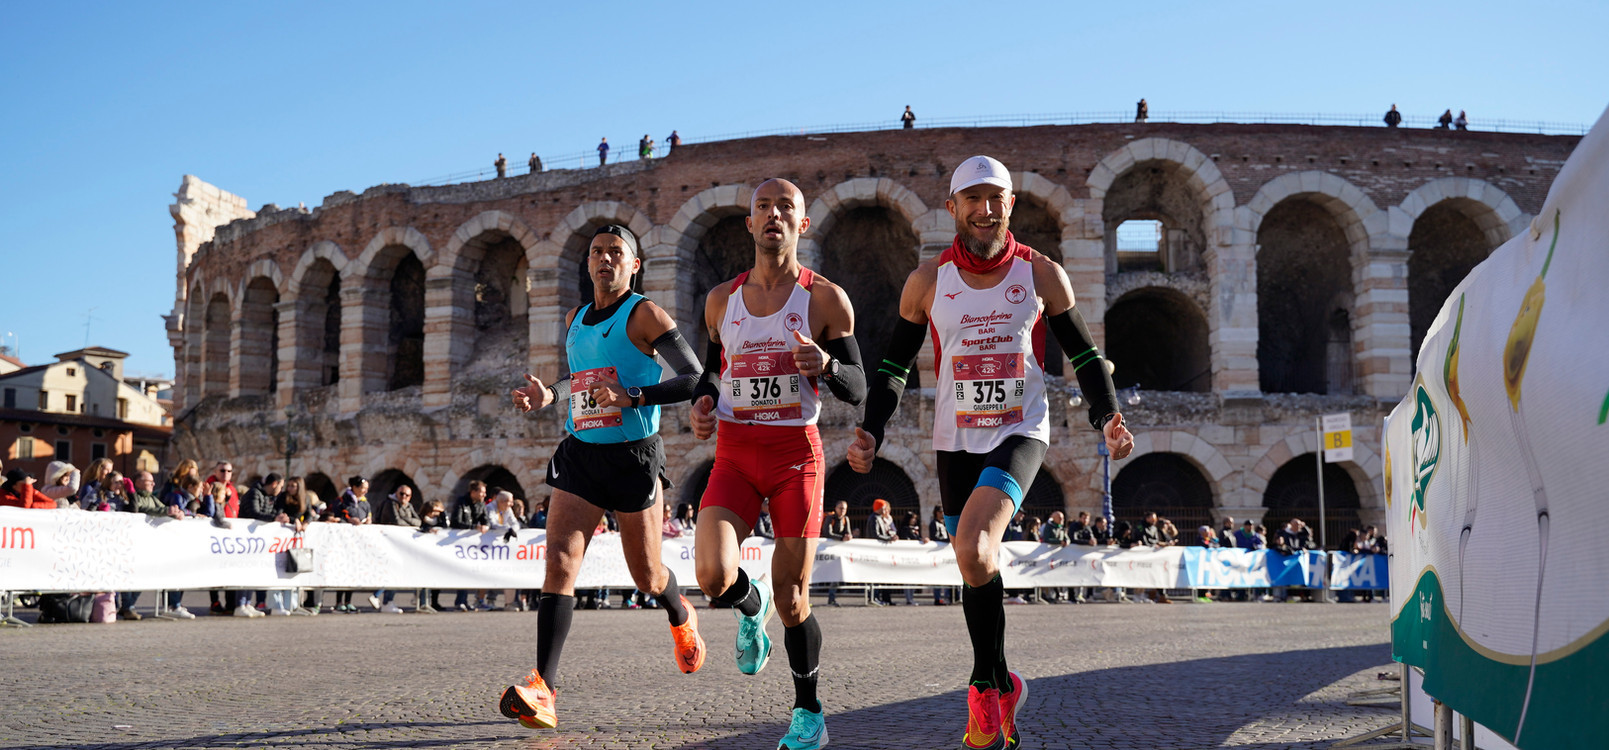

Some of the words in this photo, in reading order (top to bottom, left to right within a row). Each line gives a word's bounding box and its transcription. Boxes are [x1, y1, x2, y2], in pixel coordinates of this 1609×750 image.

[960, 310, 1013, 327] Biancofarina
[742, 337, 787, 352] Biancofarina
[961, 335, 1013, 348] SportClub
[749, 377, 782, 399] 376
[972, 380, 1006, 404] 375
[973, 403, 999, 411] GIUSEPPE
[754, 411, 781, 420] HOKA
[977, 416, 1003, 427] HOKA
[581, 420, 604, 429] HOKA
[1334, 432, 1343, 448] B
[1, 526, 35, 550] im
